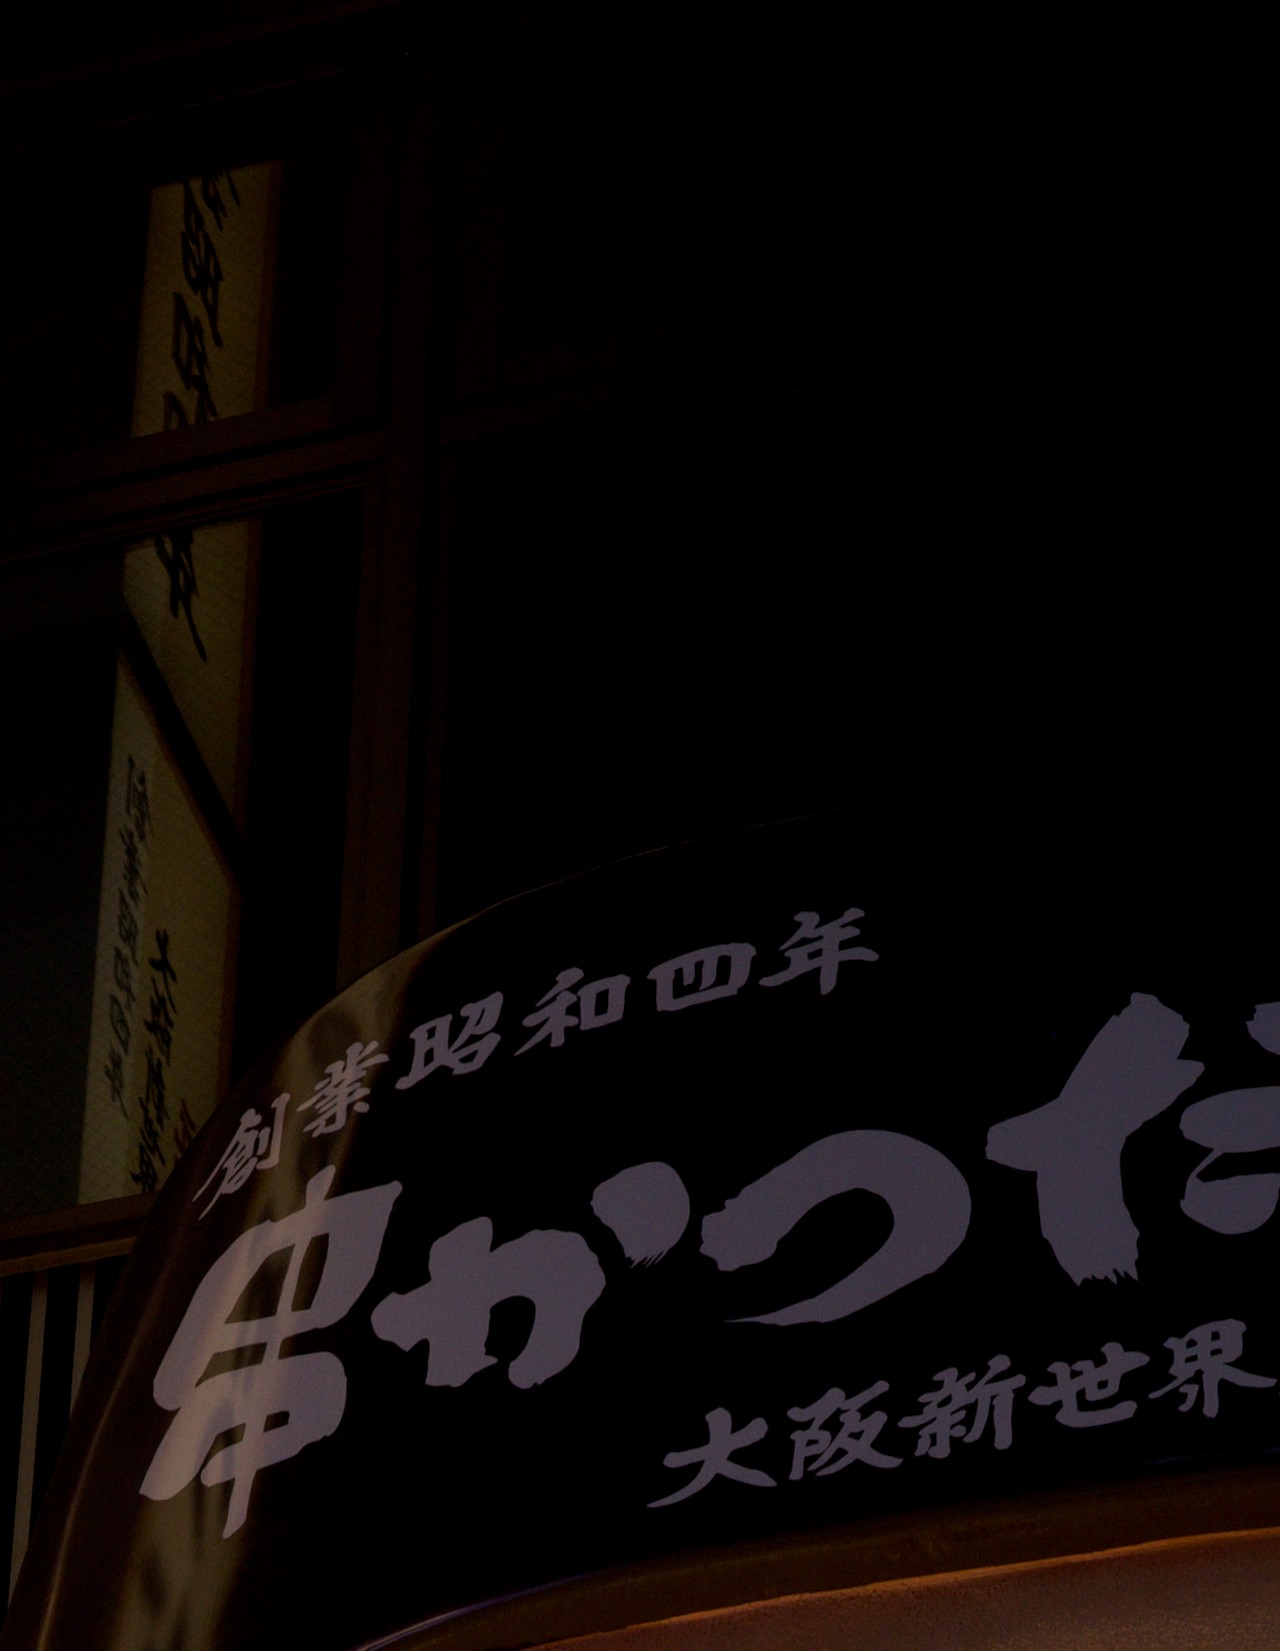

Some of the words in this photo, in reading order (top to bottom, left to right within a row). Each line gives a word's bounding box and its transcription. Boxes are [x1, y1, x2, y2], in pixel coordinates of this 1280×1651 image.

[193, 907, 880, 1221] 創業昭和四年
